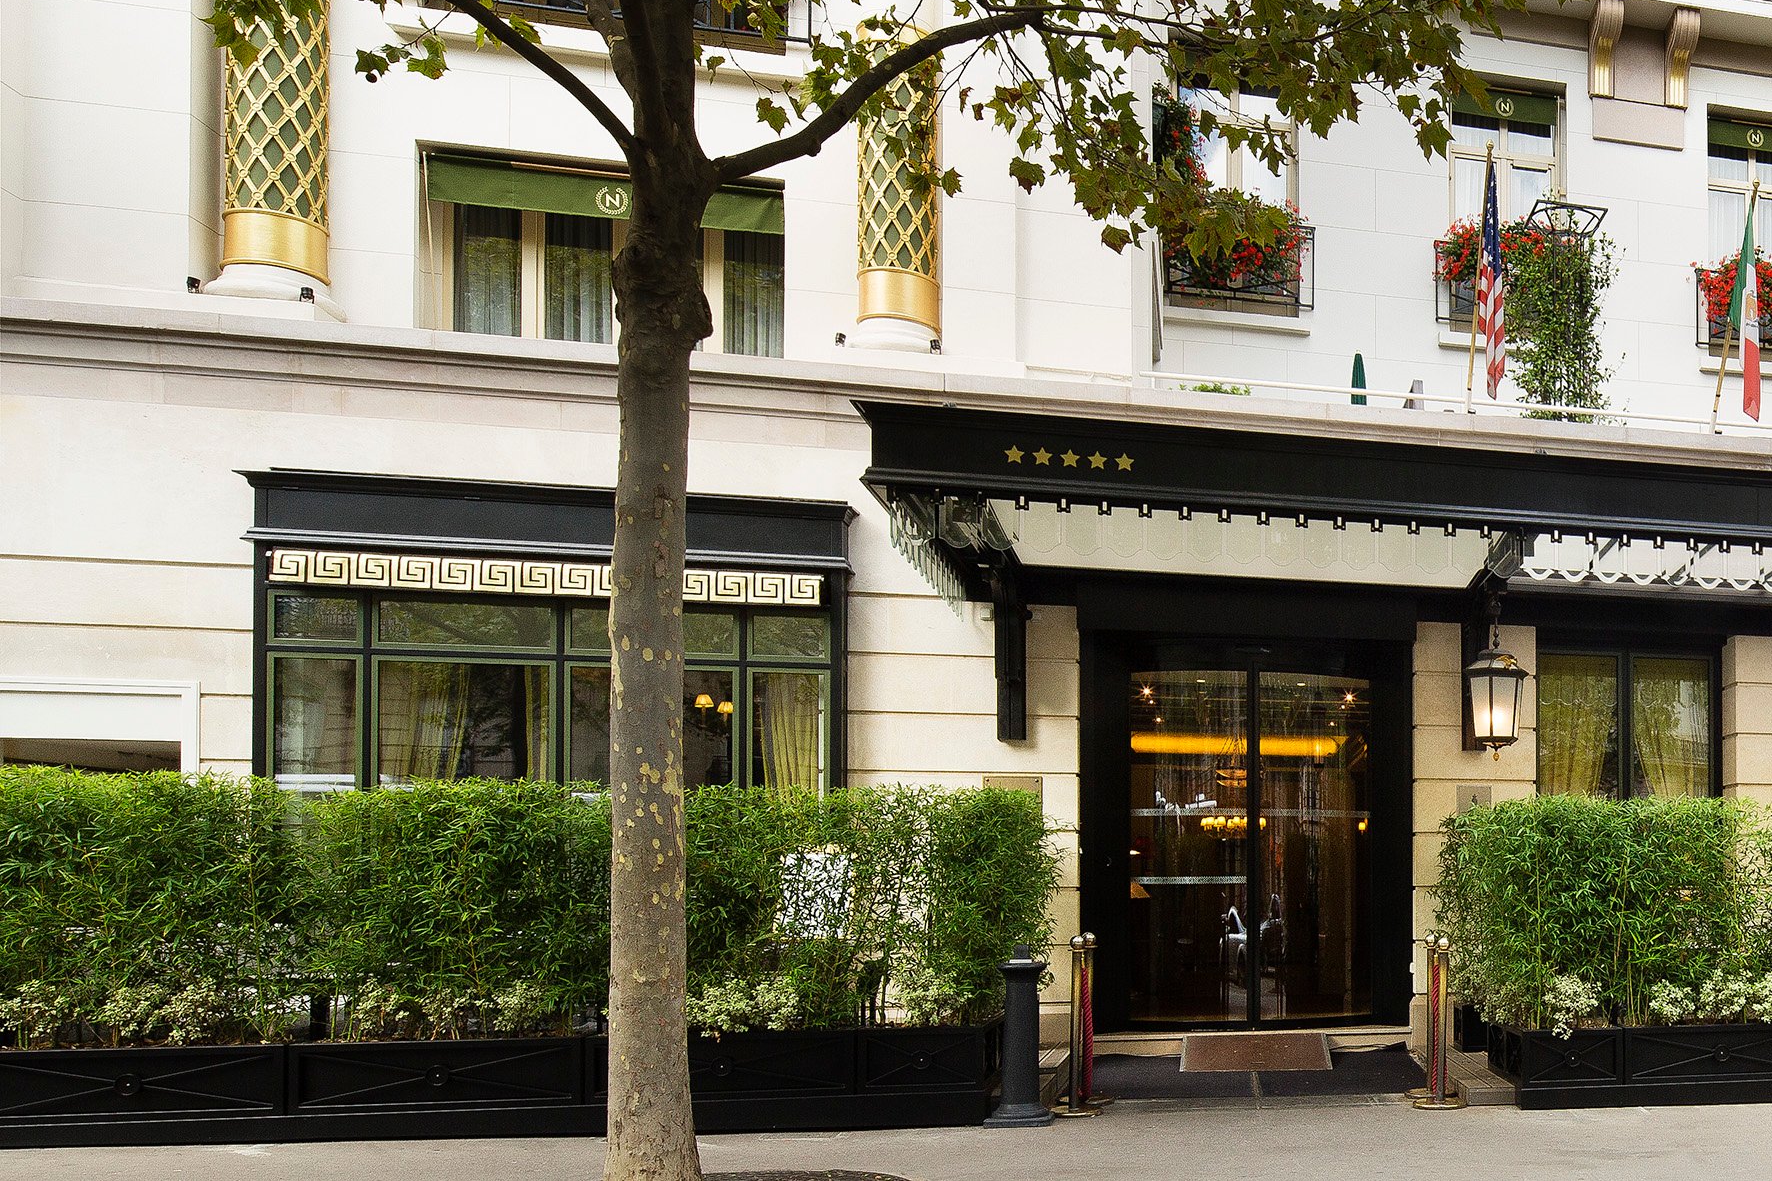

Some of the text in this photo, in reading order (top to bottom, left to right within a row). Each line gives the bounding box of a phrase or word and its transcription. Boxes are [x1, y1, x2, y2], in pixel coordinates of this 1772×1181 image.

[1501, 102, 1509, 112] N
[1752, 132, 1760, 142] N
[605, 193, 620, 208] N
